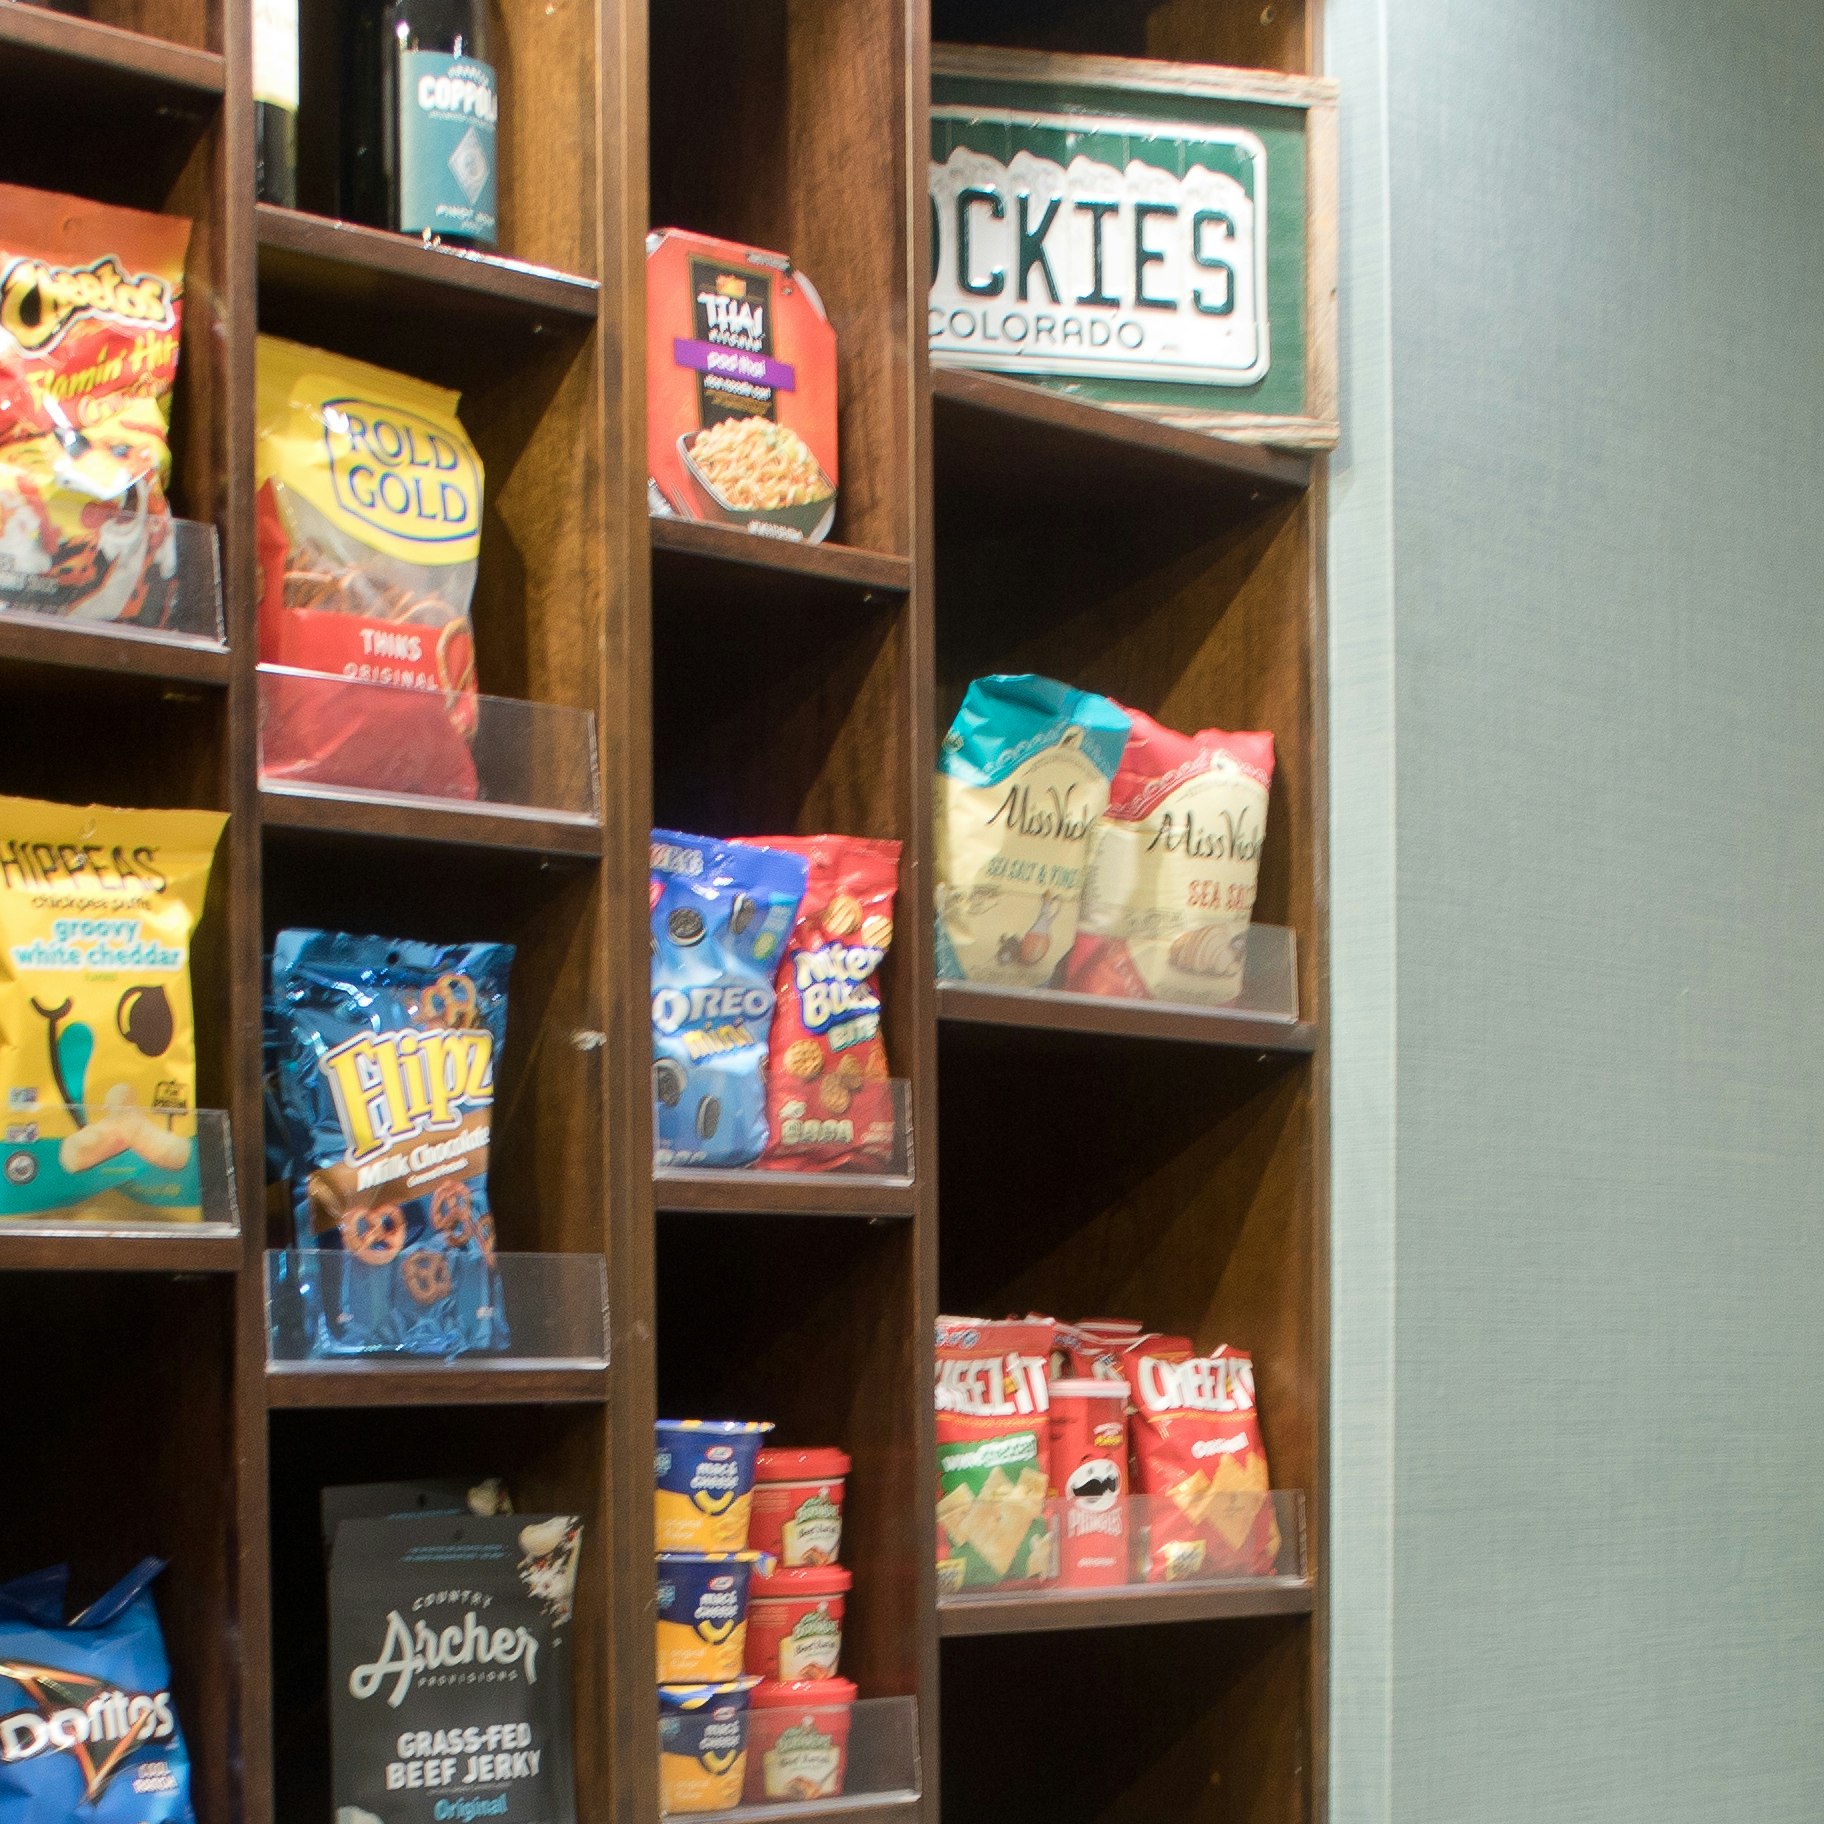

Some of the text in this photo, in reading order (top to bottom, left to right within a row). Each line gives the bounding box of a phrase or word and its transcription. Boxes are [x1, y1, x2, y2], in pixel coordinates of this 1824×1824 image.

[348, 411, 459, 473] ROLD
[347, 466, 469, 526] GOLD
[52, 918, 141, 945] groovy
[13, 941, 183, 968] white cheddar
[651, 986, 776, 1034] OREO
[324, 1031, 494, 1162] Flipz
[356, 1151, 412, 1194] Milk
[349, 1609, 539, 1709] Archer
[396, 1722, 532, 1760] GRASS-FED
[385, 1748, 542, 1791] BEEF JERKY
[433, 1793, 508, 1824] Original
